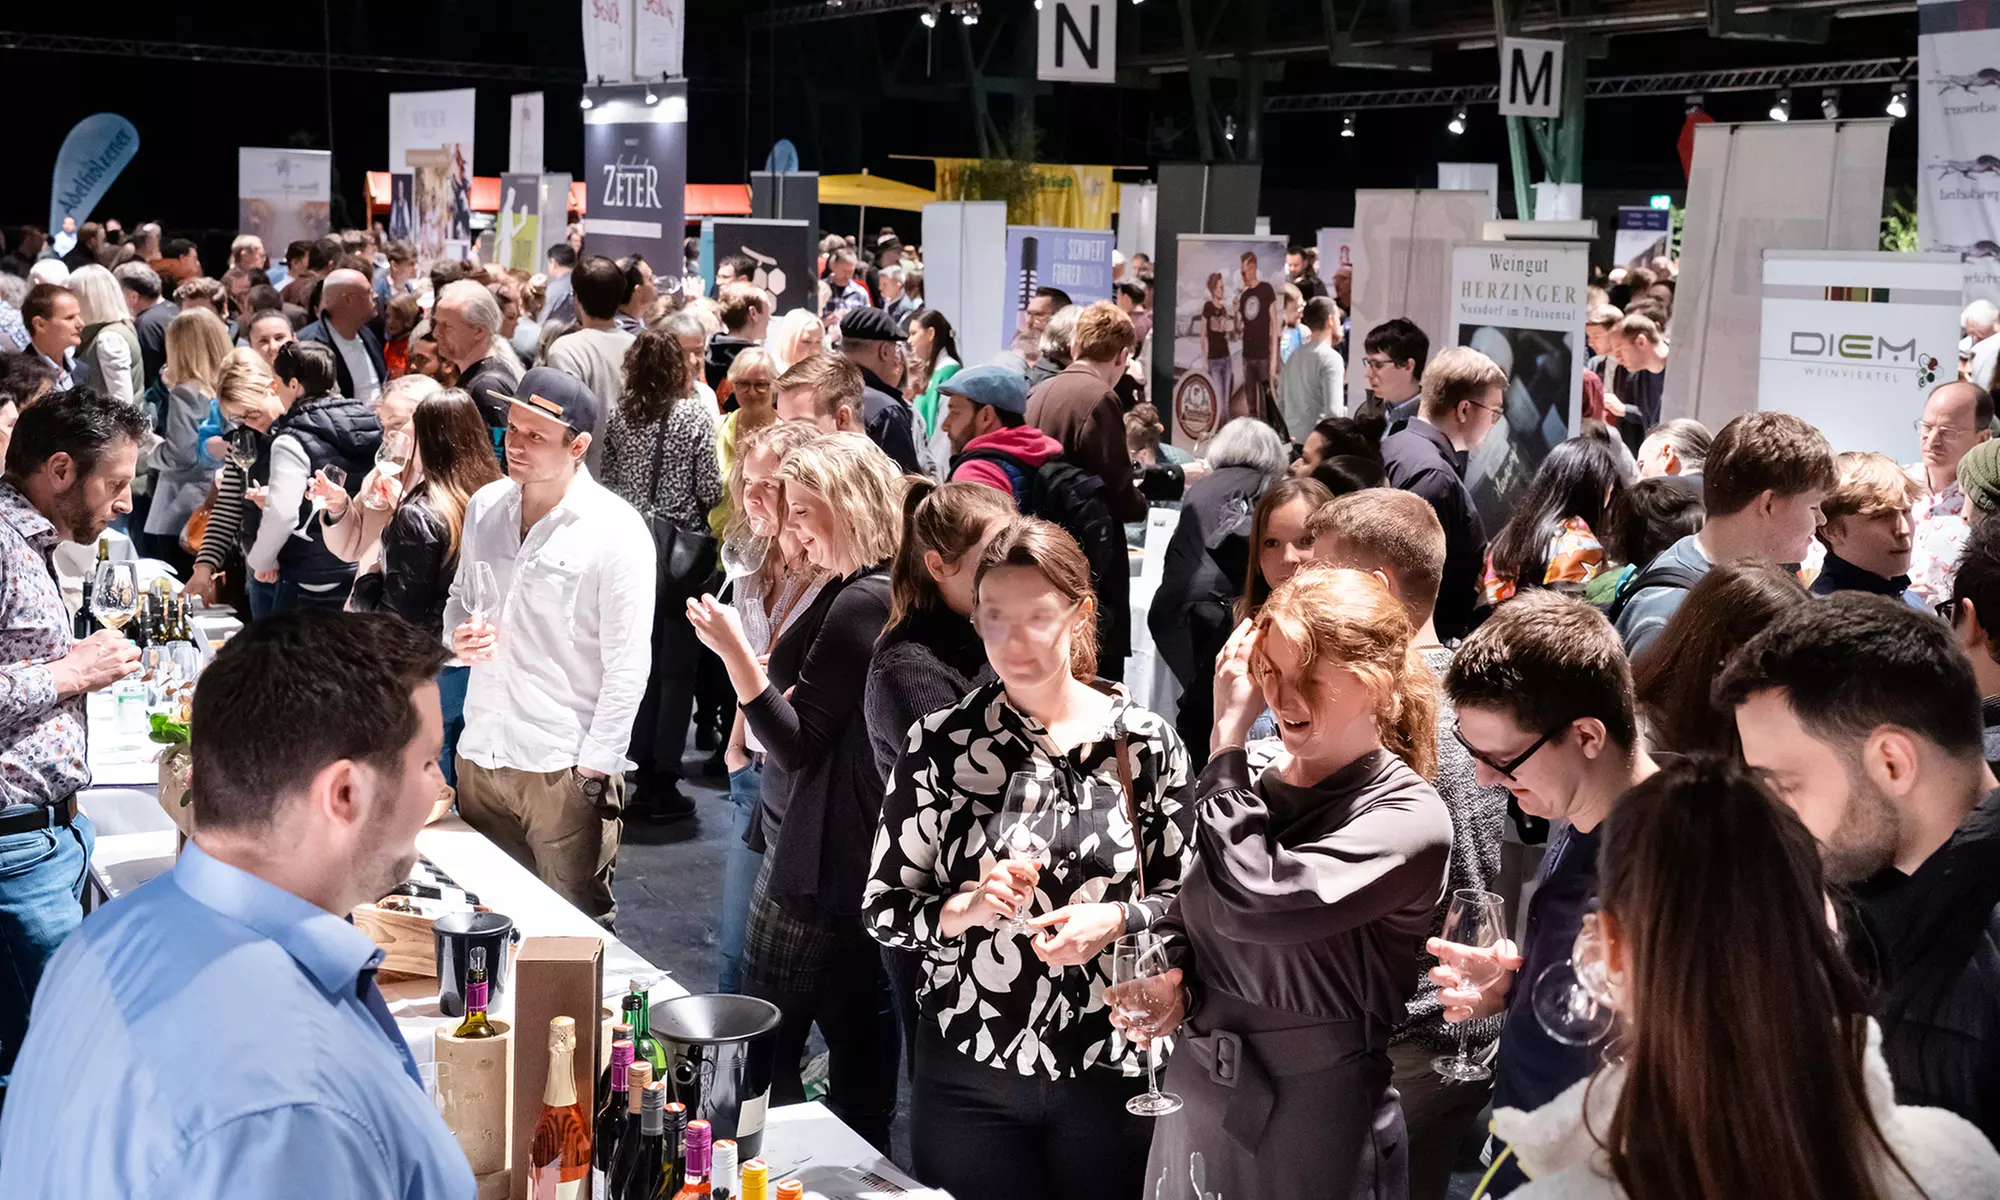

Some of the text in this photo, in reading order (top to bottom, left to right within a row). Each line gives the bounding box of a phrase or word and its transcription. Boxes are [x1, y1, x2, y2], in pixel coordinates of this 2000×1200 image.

[1055, 3, 1099, 69] N
[1509, 48, 1553, 106] M
[603, 164, 662, 209] ZETER
[1490, 253, 1549, 277] Weingut
[1461, 281, 1576, 304] HERZINGER
[1523, 306, 1576, 321] Traisental
[1790, 331, 1916, 362] DIEM
[1804, 367, 1899, 384] WEINVIERTEL
